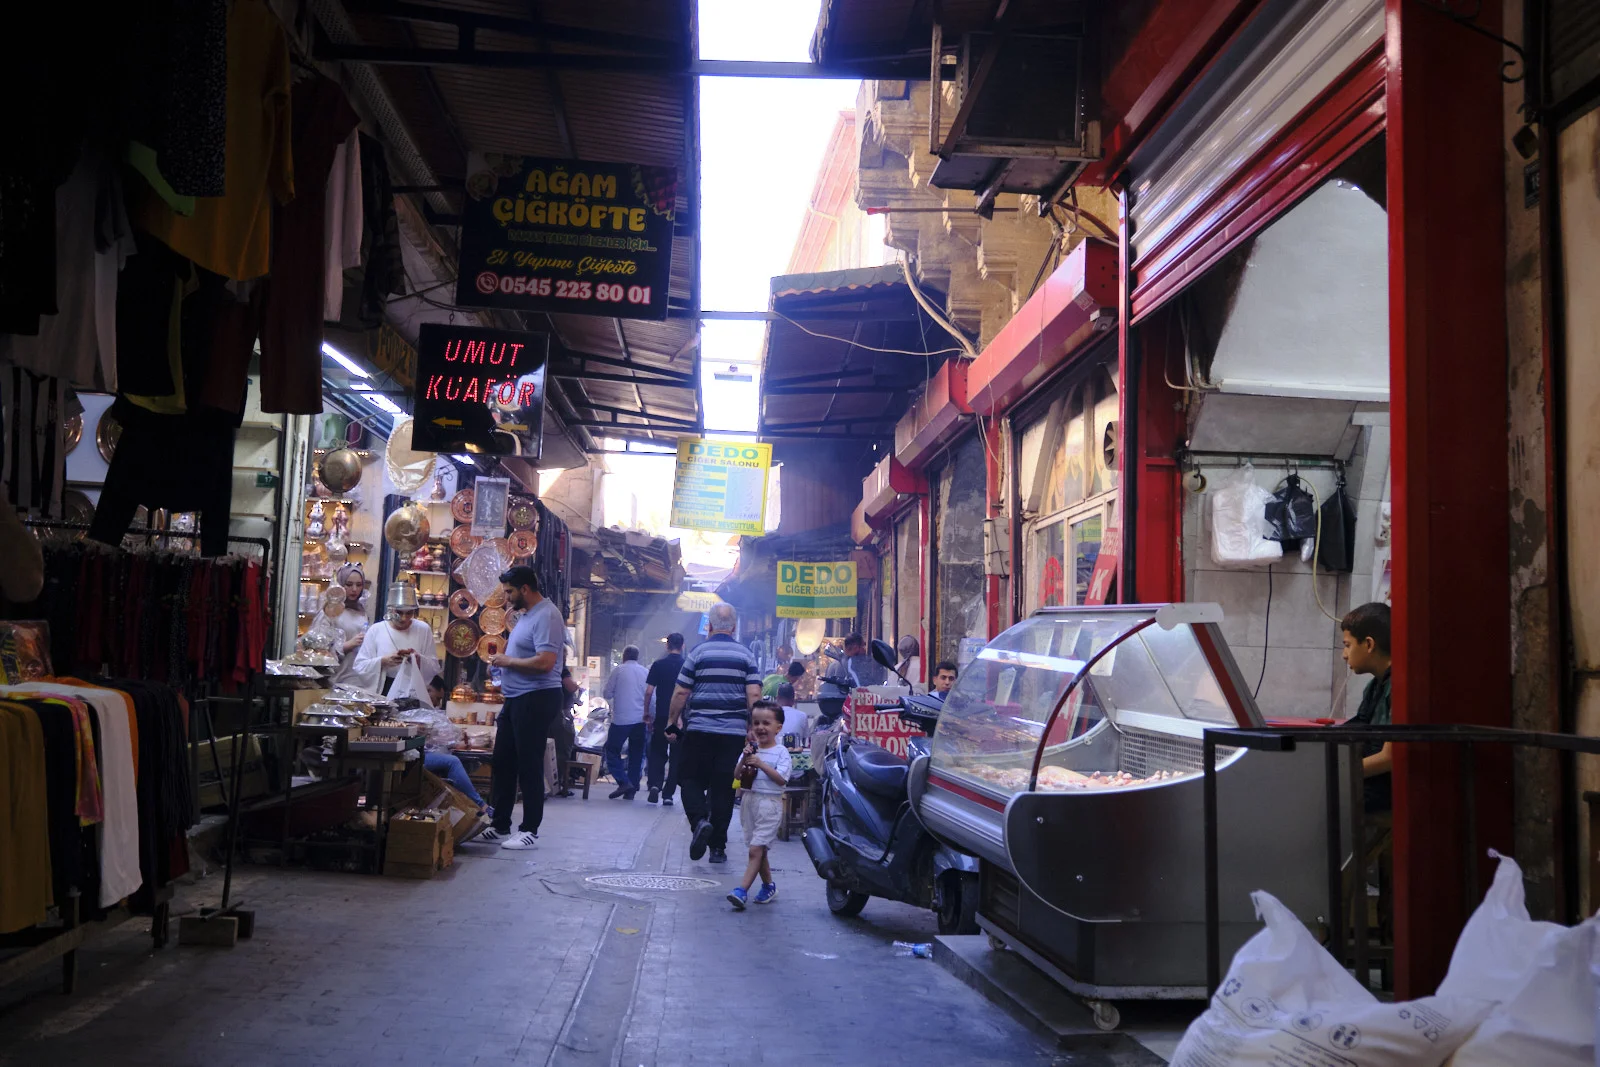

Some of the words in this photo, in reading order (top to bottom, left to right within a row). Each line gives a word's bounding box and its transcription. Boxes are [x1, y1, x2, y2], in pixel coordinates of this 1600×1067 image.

[525, 165, 617, 199] AĞAM
[491, 193, 647, 232] ÇİĞKÖFTE
[487, 249, 508, 265] El
[514, 251, 575, 271] Yapımı
[499, 276, 552, 296] 0545
[555, 279, 592, 299] 223
[595, 283, 625, 302] 80
[627, 286, 653, 305] 01
[444, 340, 525, 367] UMUT
[688, 443, 759, 460] DEDO
[719, 459, 760, 468] SALONU
[781, 563, 852, 584] DEDO
[785, 584, 811, 594] CİĞER
[813, 585, 848, 595] SALONU
